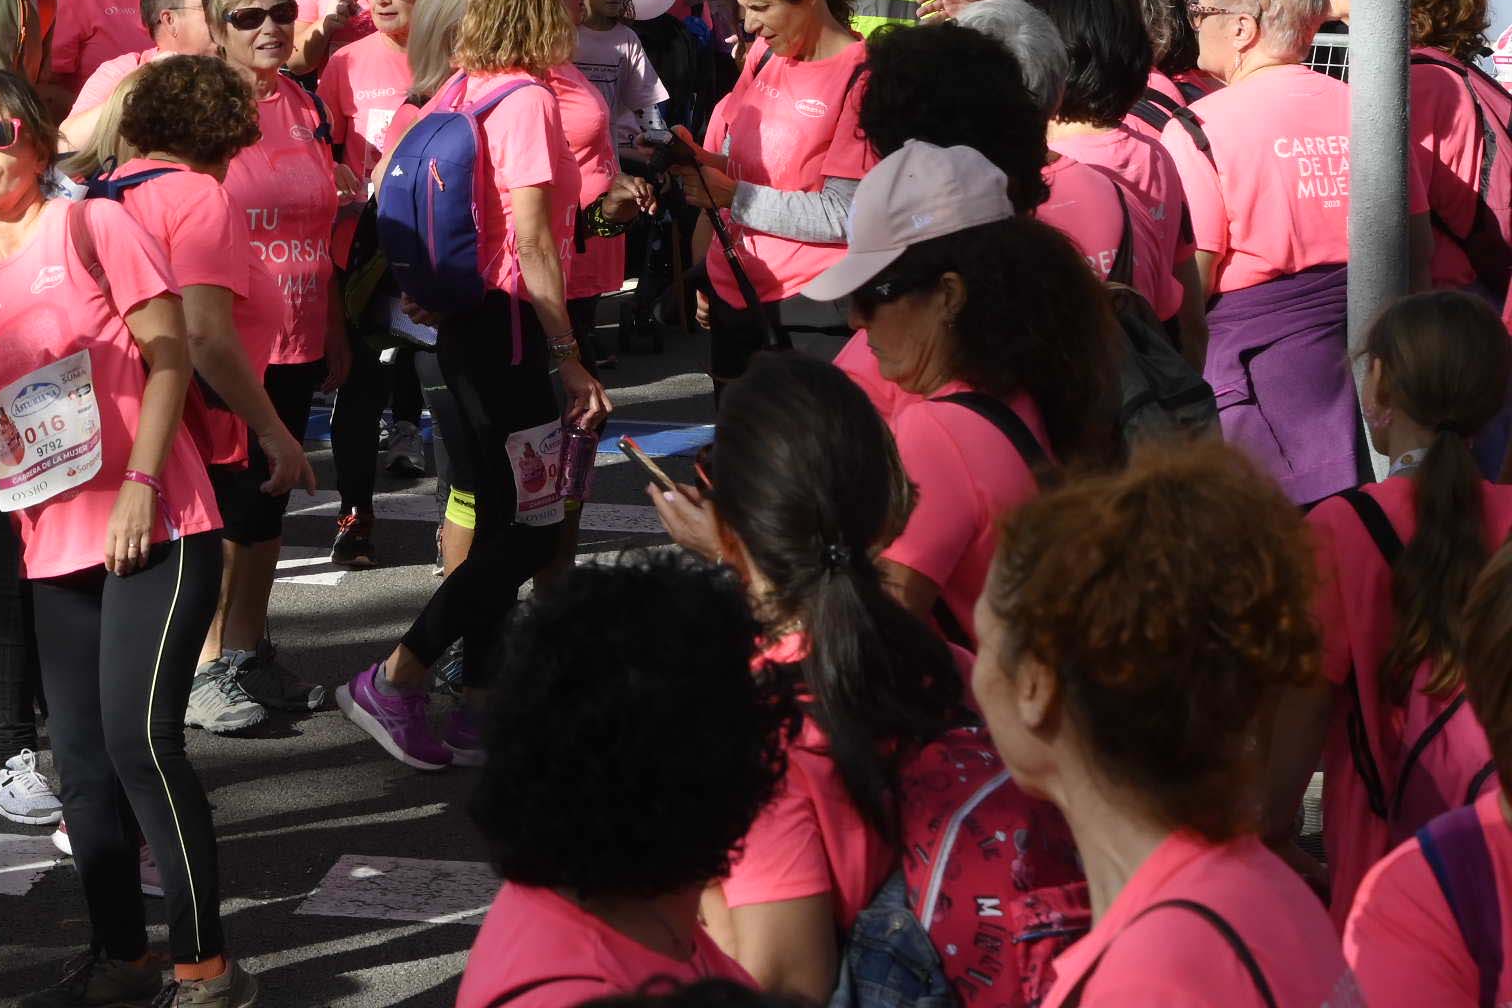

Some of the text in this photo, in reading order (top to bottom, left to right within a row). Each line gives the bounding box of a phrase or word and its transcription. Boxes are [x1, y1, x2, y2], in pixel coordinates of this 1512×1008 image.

[356, 87, 396, 100] OYSHO
[1299, 158, 1350, 176] DE LA
[1297, 177, 1349, 199] MUJE
[246, 207, 279, 231] TU
[62, 369, 87, 384] SUMA
[24, 415, 66, 445] 016
[36, 438, 63, 457] 9792
[11, 445, 88, 485] CARRERA DE LA MUJER
[11, 480, 48, 502] OYSHO
